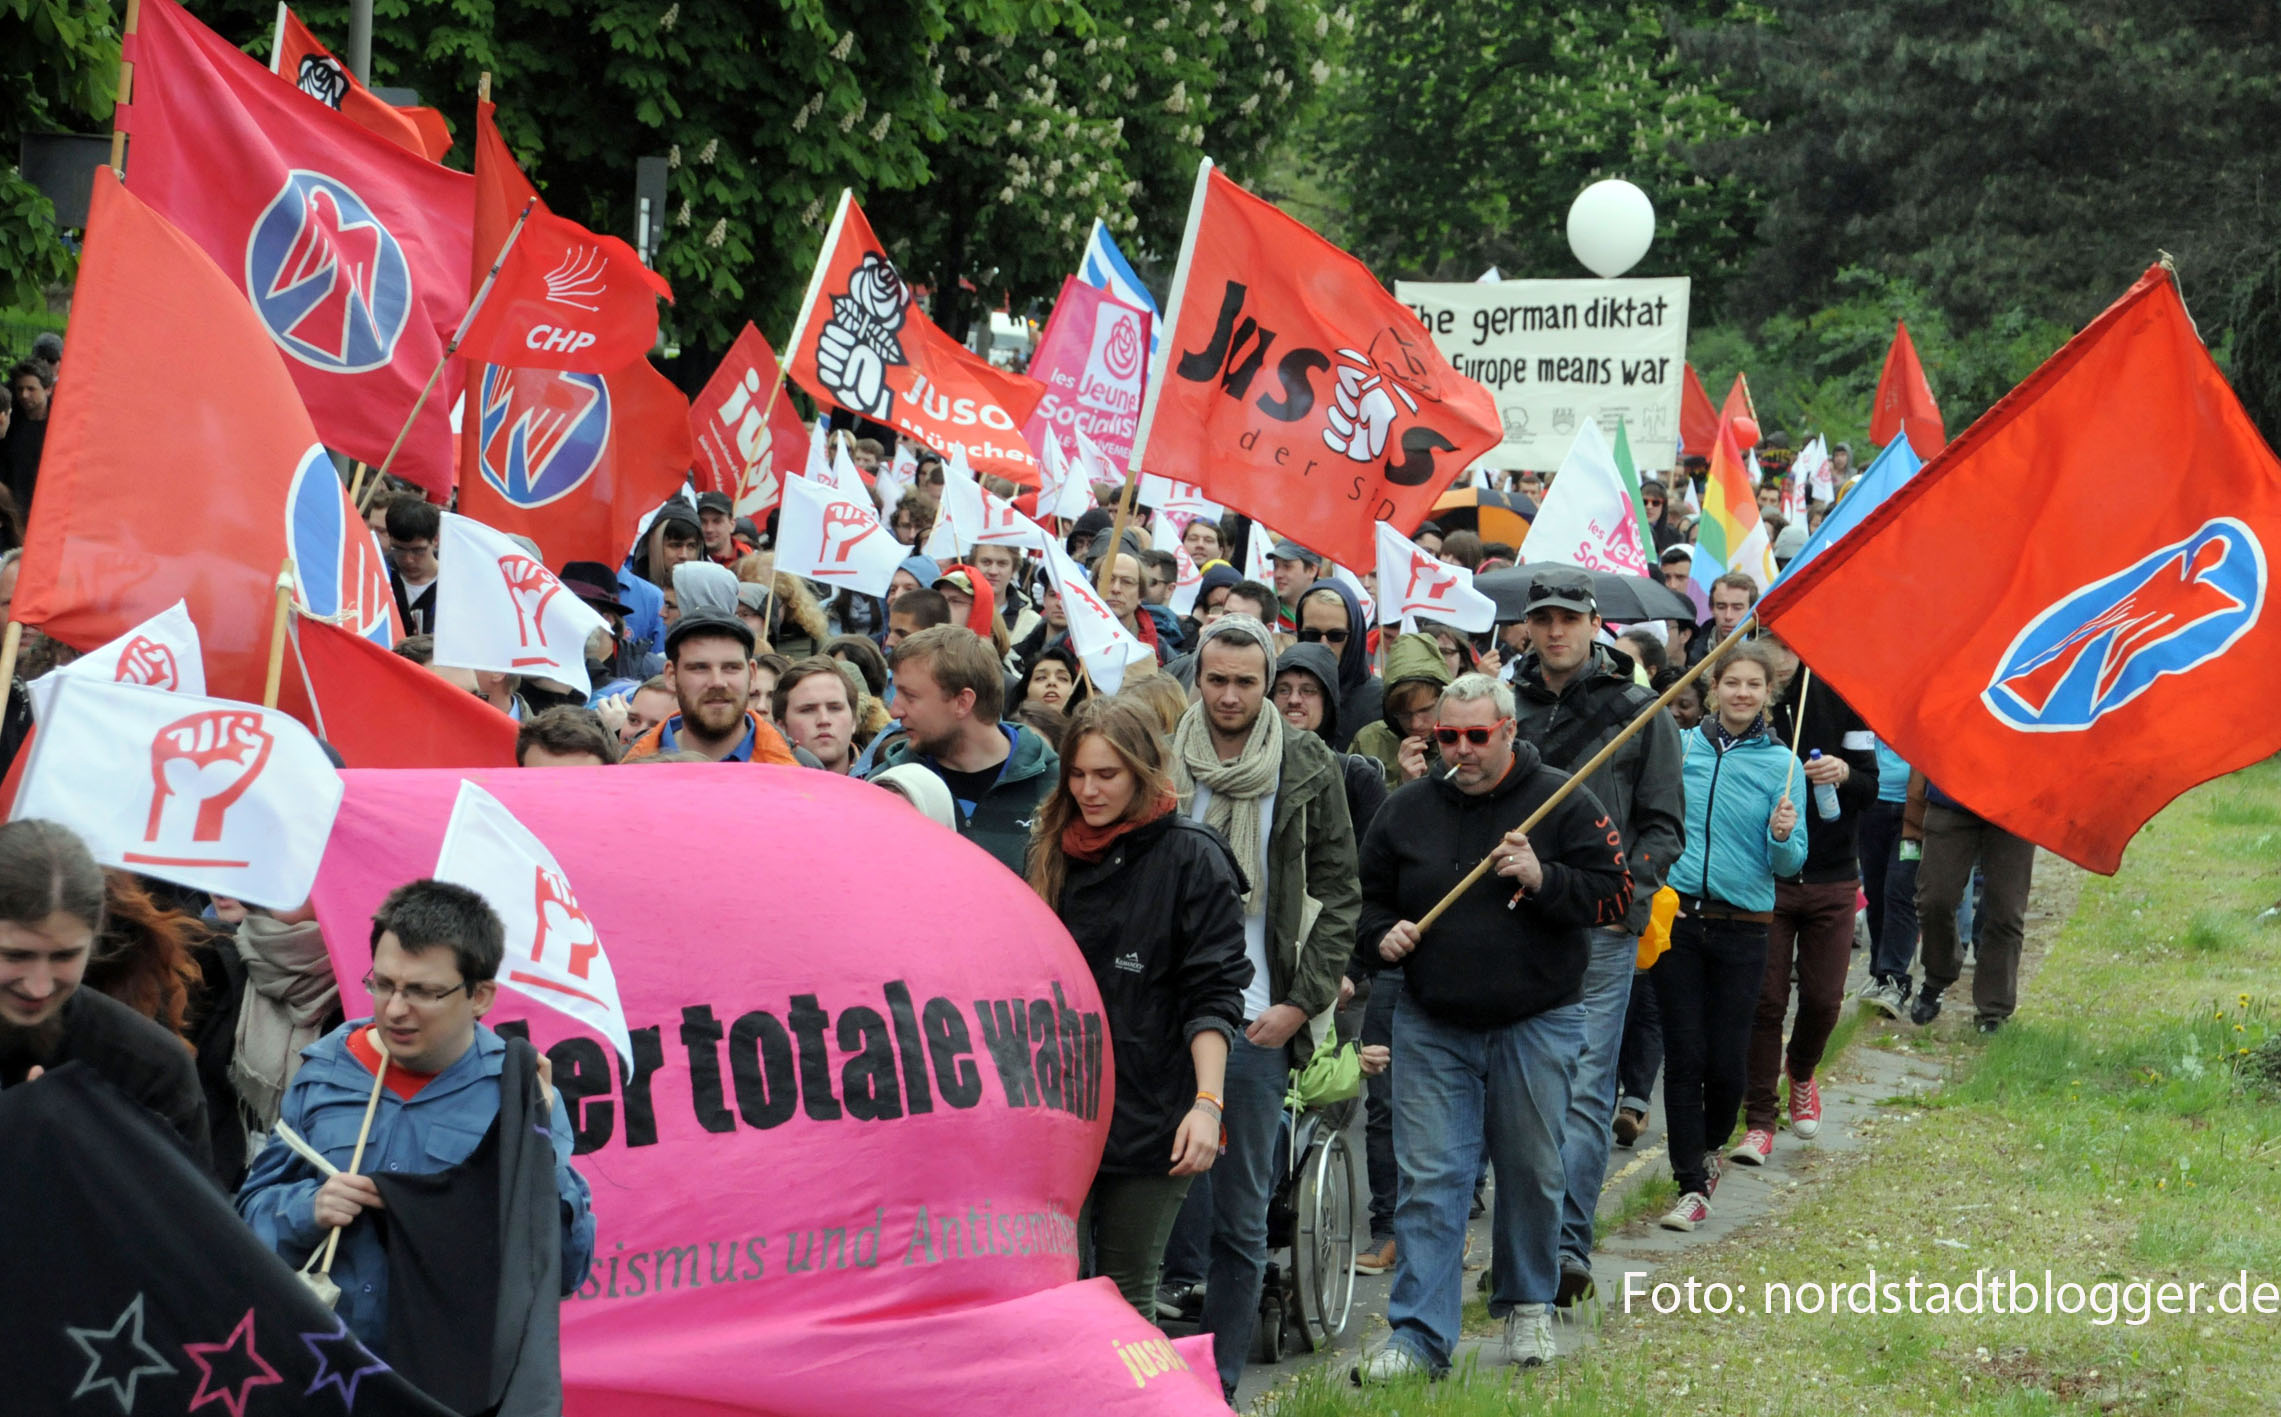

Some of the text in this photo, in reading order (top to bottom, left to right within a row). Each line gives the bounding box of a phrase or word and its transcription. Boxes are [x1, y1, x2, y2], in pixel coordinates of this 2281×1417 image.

[526, 324, 597, 353] CHP
[1407, 295, 1668, 345] he german diktat
[1050, 367, 1138, 411] les Jeune
[1453, 354, 1670, 390] Europe means war
[902, 373, 1025, 438] JUSO
[1240, 429, 1396, 522] der SD
[1587, 517, 1606, 541] les
[681, 980, 983, 1133] totale
[974, 981, 1103, 1121] wahn
[562, 1236, 768, 1301] sismus
[787, 1206, 884, 1270] und
